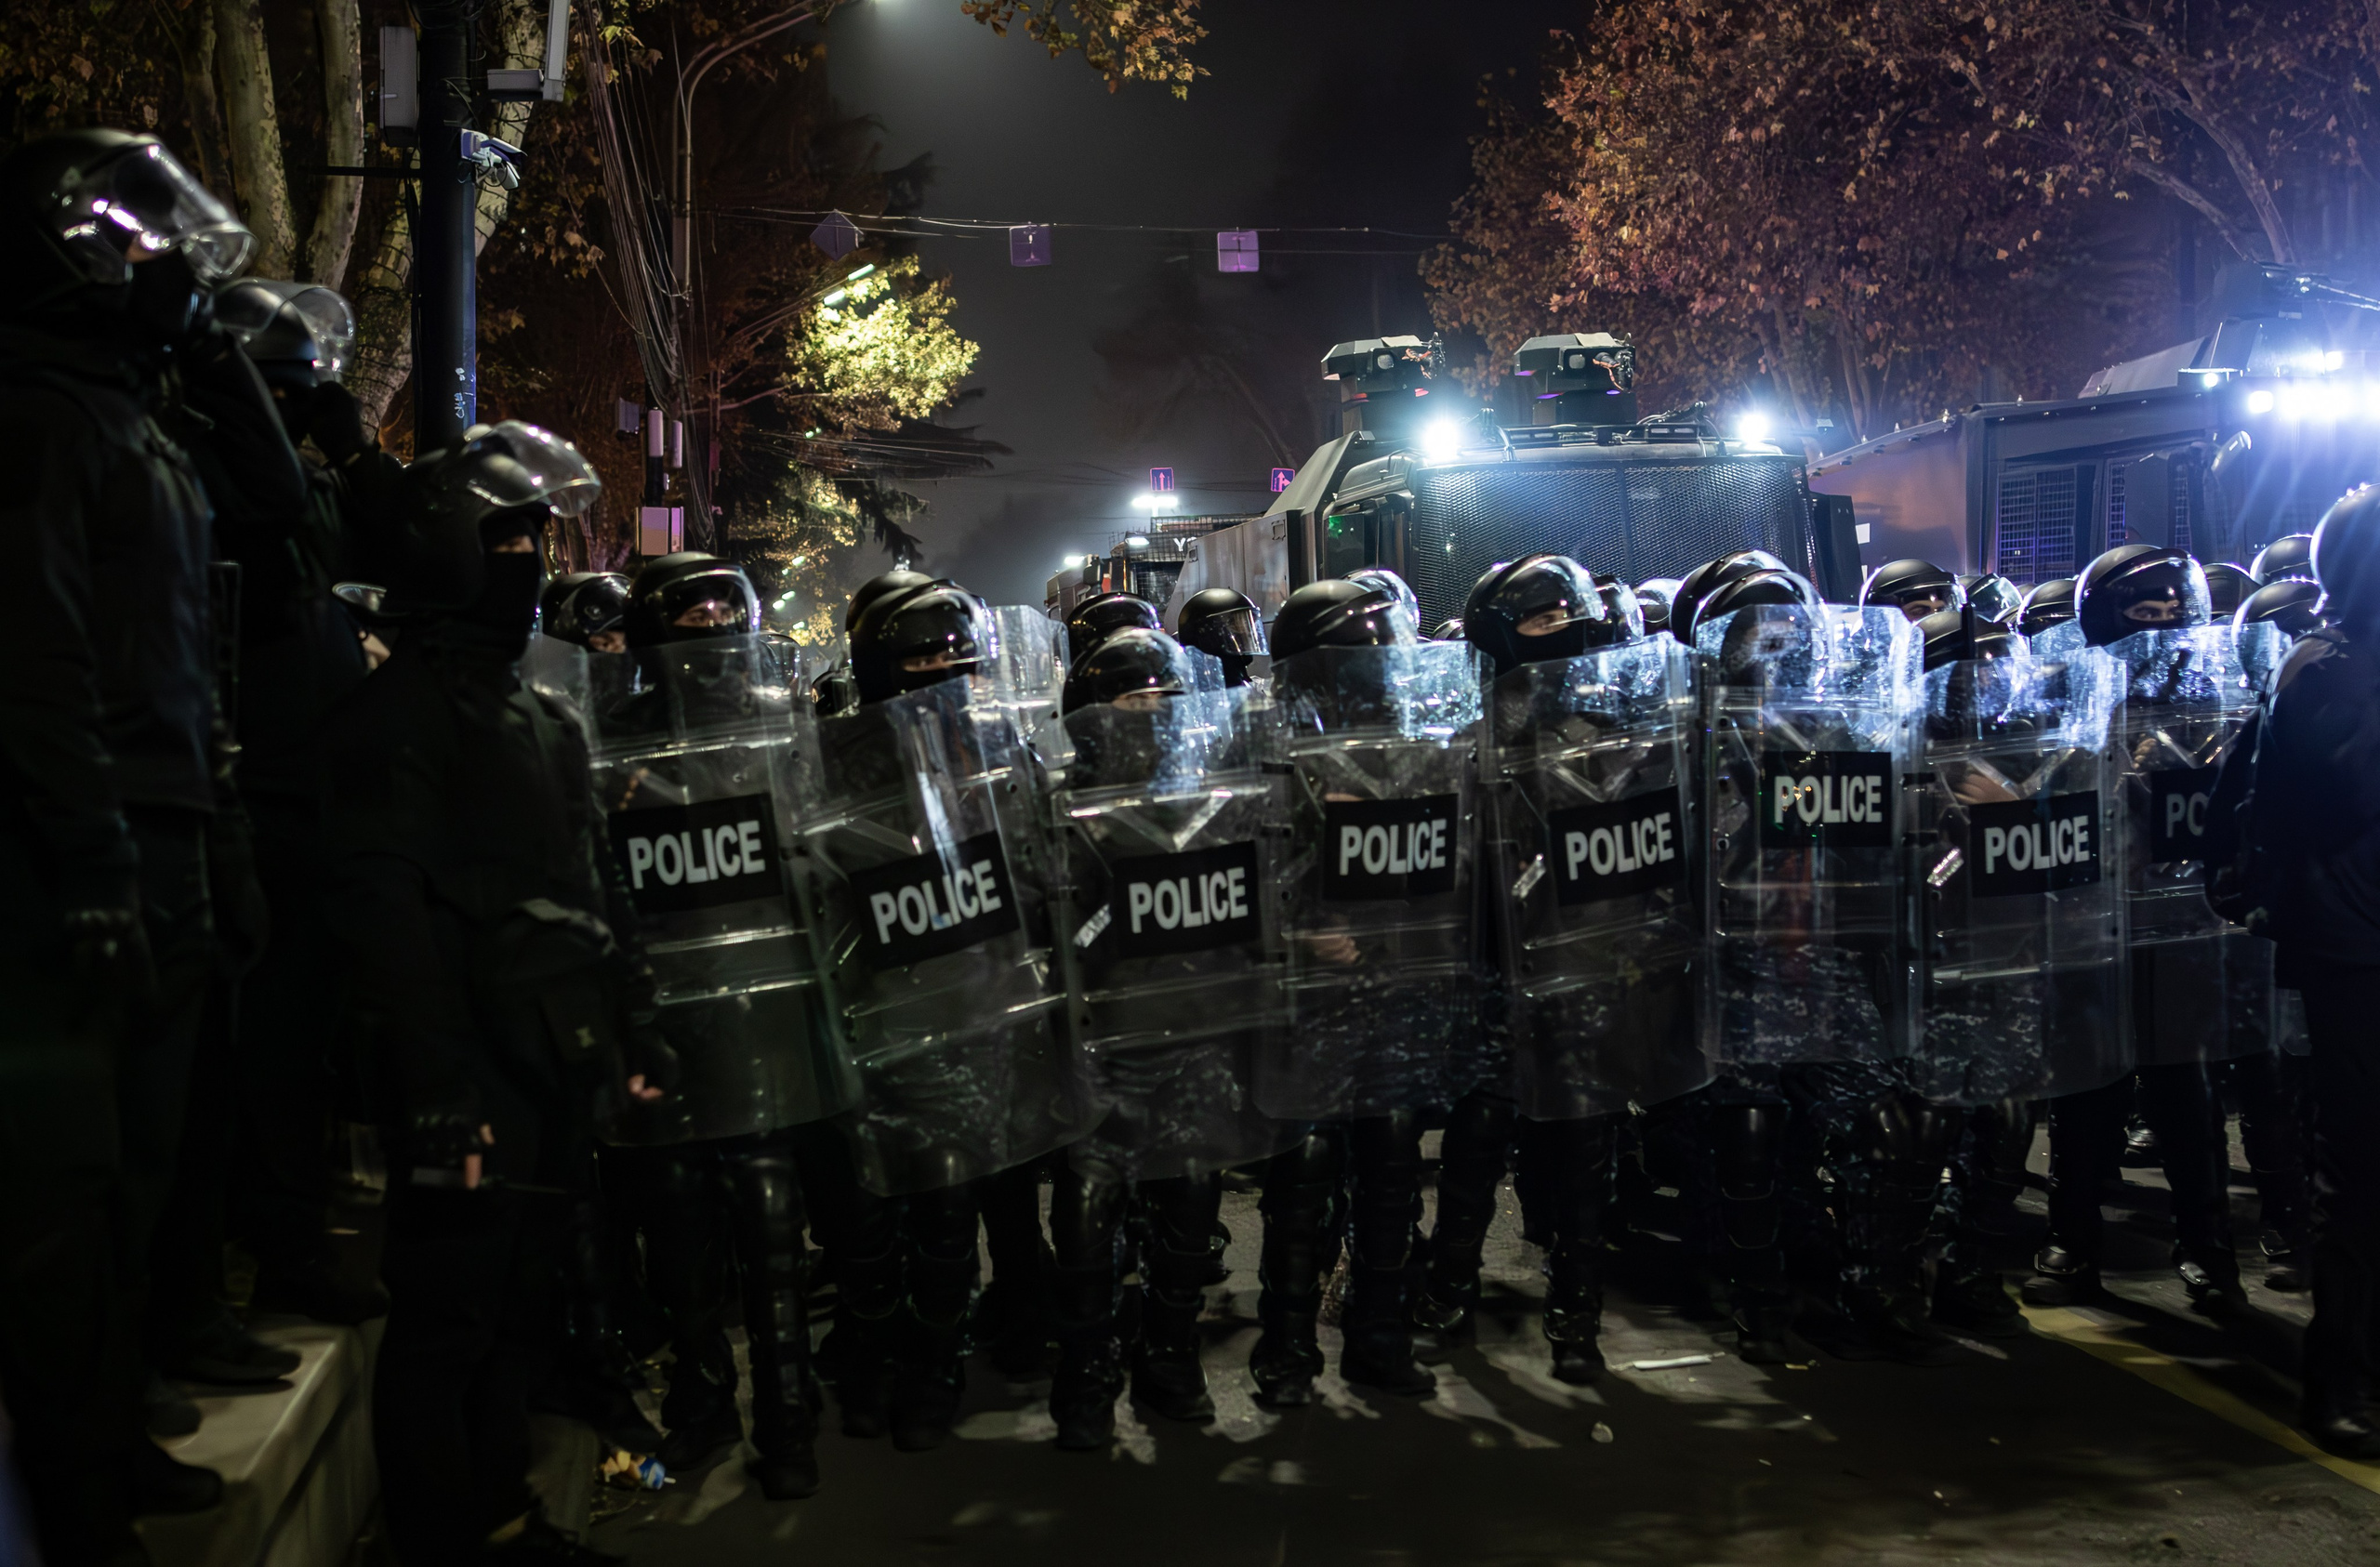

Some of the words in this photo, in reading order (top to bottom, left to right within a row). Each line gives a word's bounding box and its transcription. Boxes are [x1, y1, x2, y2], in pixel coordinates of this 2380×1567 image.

[1774, 775, 1883, 823] POLICE
[628, 820, 766, 889] POLICE
[1339, 818, 1448, 876] POLICE
[1565, 811, 1675, 881] POLICE
[1984, 814, 2090, 875] POLICE
[869, 858, 1003, 944] POLICE
[1128, 866, 1249, 934] POLICE
